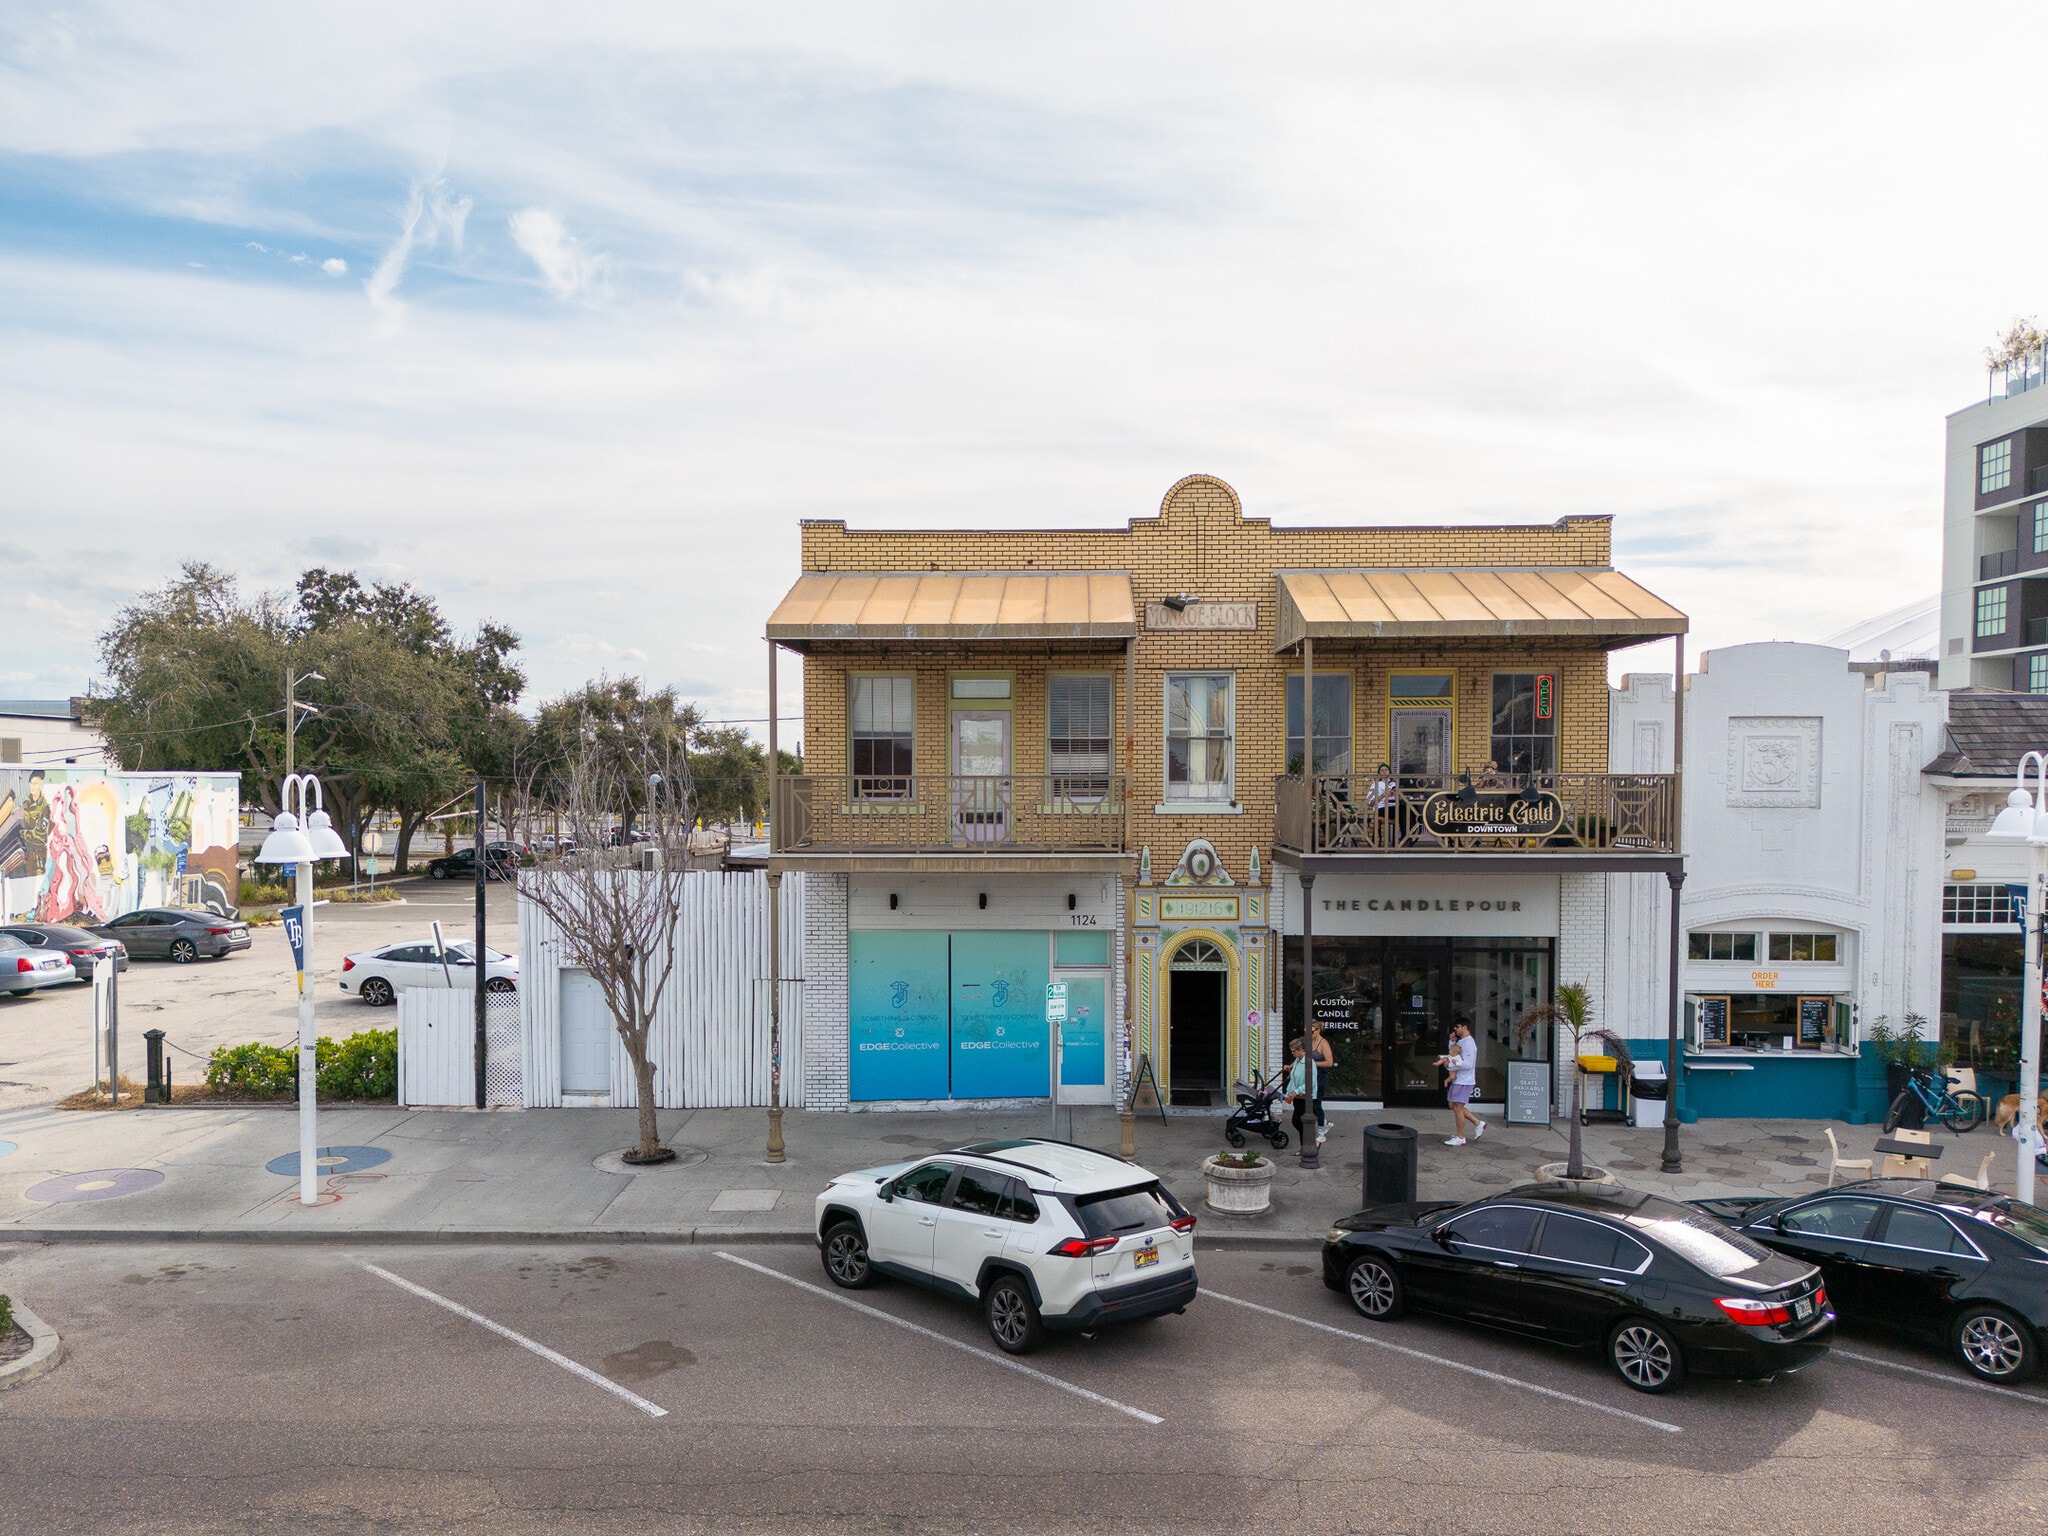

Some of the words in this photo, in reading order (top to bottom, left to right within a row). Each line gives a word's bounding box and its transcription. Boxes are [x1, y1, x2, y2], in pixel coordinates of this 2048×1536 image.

[1209, 605, 1255, 627] BLOCK
[1540, 678, 1550, 717] OPEN
[1433, 800, 1504, 825] Electric
[1507, 800, 1554, 825] Gold
[1467, 825, 1518, 833] DOWNTOWN
[1071, 915, 1097, 926] 1124
[286, 917, 303, 950] TB
[1751, 972, 1779, 980] ORDER
[1755, 981, 1775, 989] HERE
[1317, 1010, 1350, 1018] CANDLE
